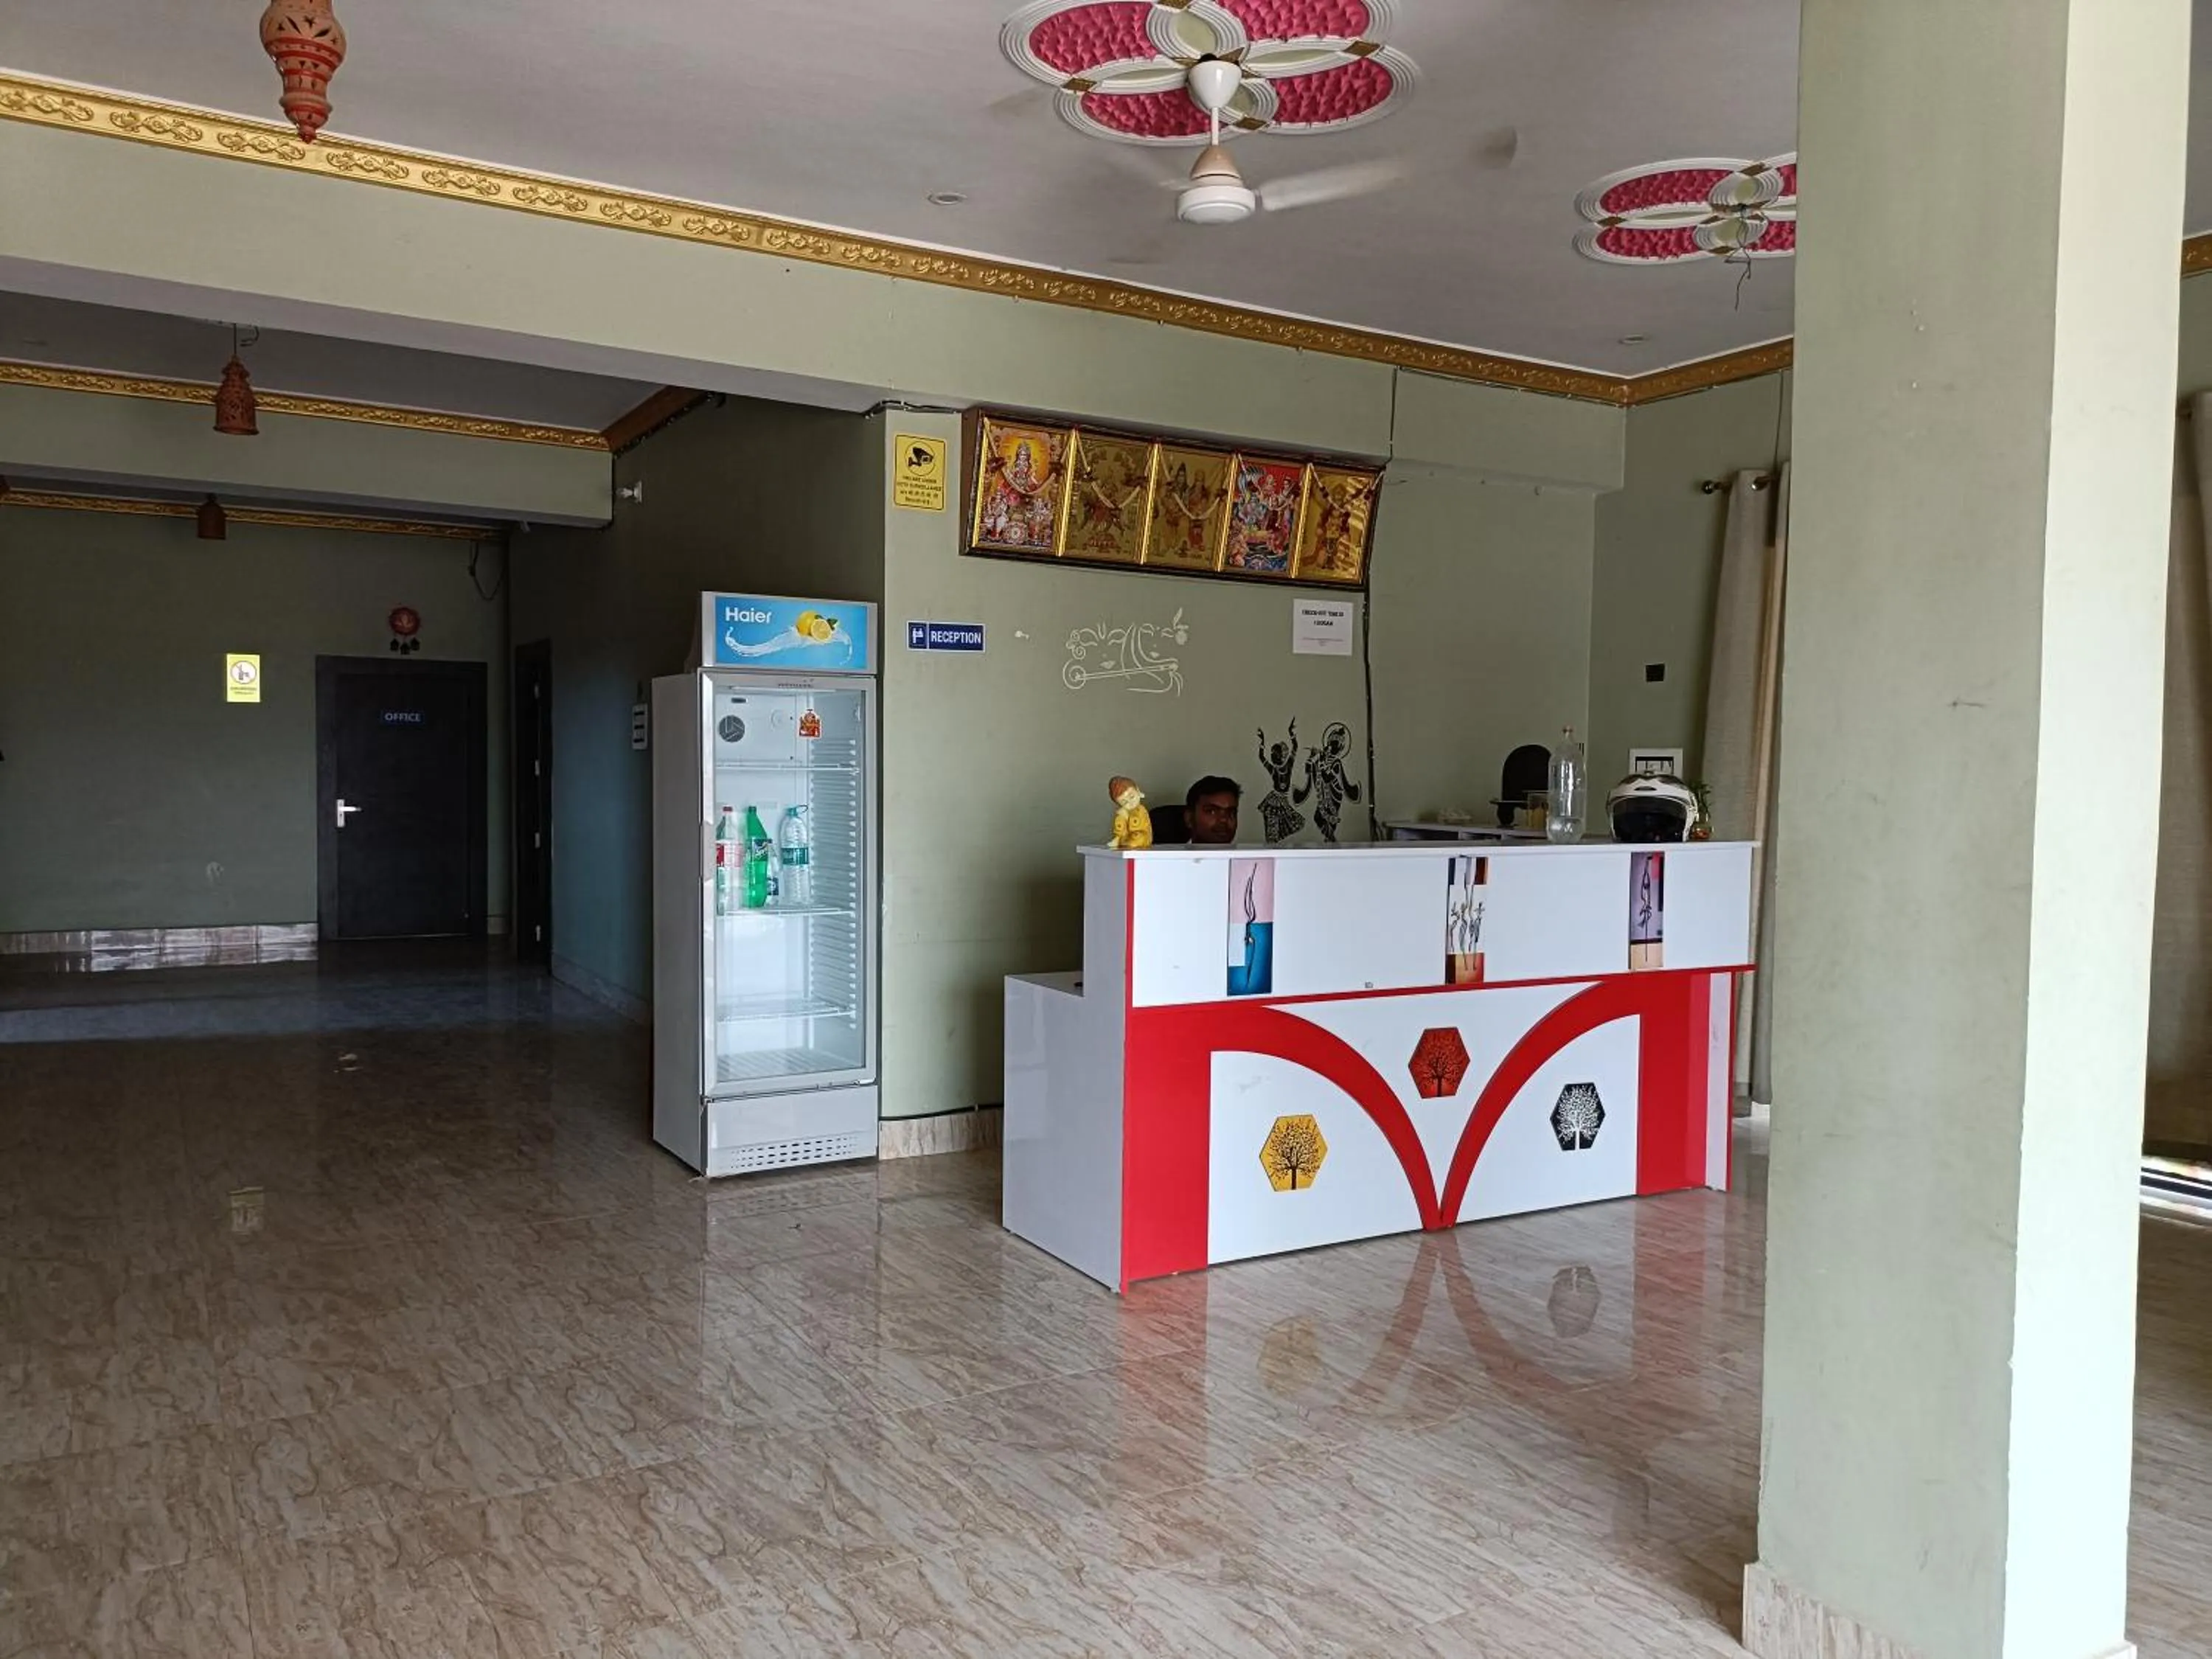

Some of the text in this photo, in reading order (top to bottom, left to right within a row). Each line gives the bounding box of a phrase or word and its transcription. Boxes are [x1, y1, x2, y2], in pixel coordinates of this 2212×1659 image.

[725, 607, 772, 624] Haier
[931, 630, 981, 644] RECEPTION
[384, 712, 421, 722] OFFICE
